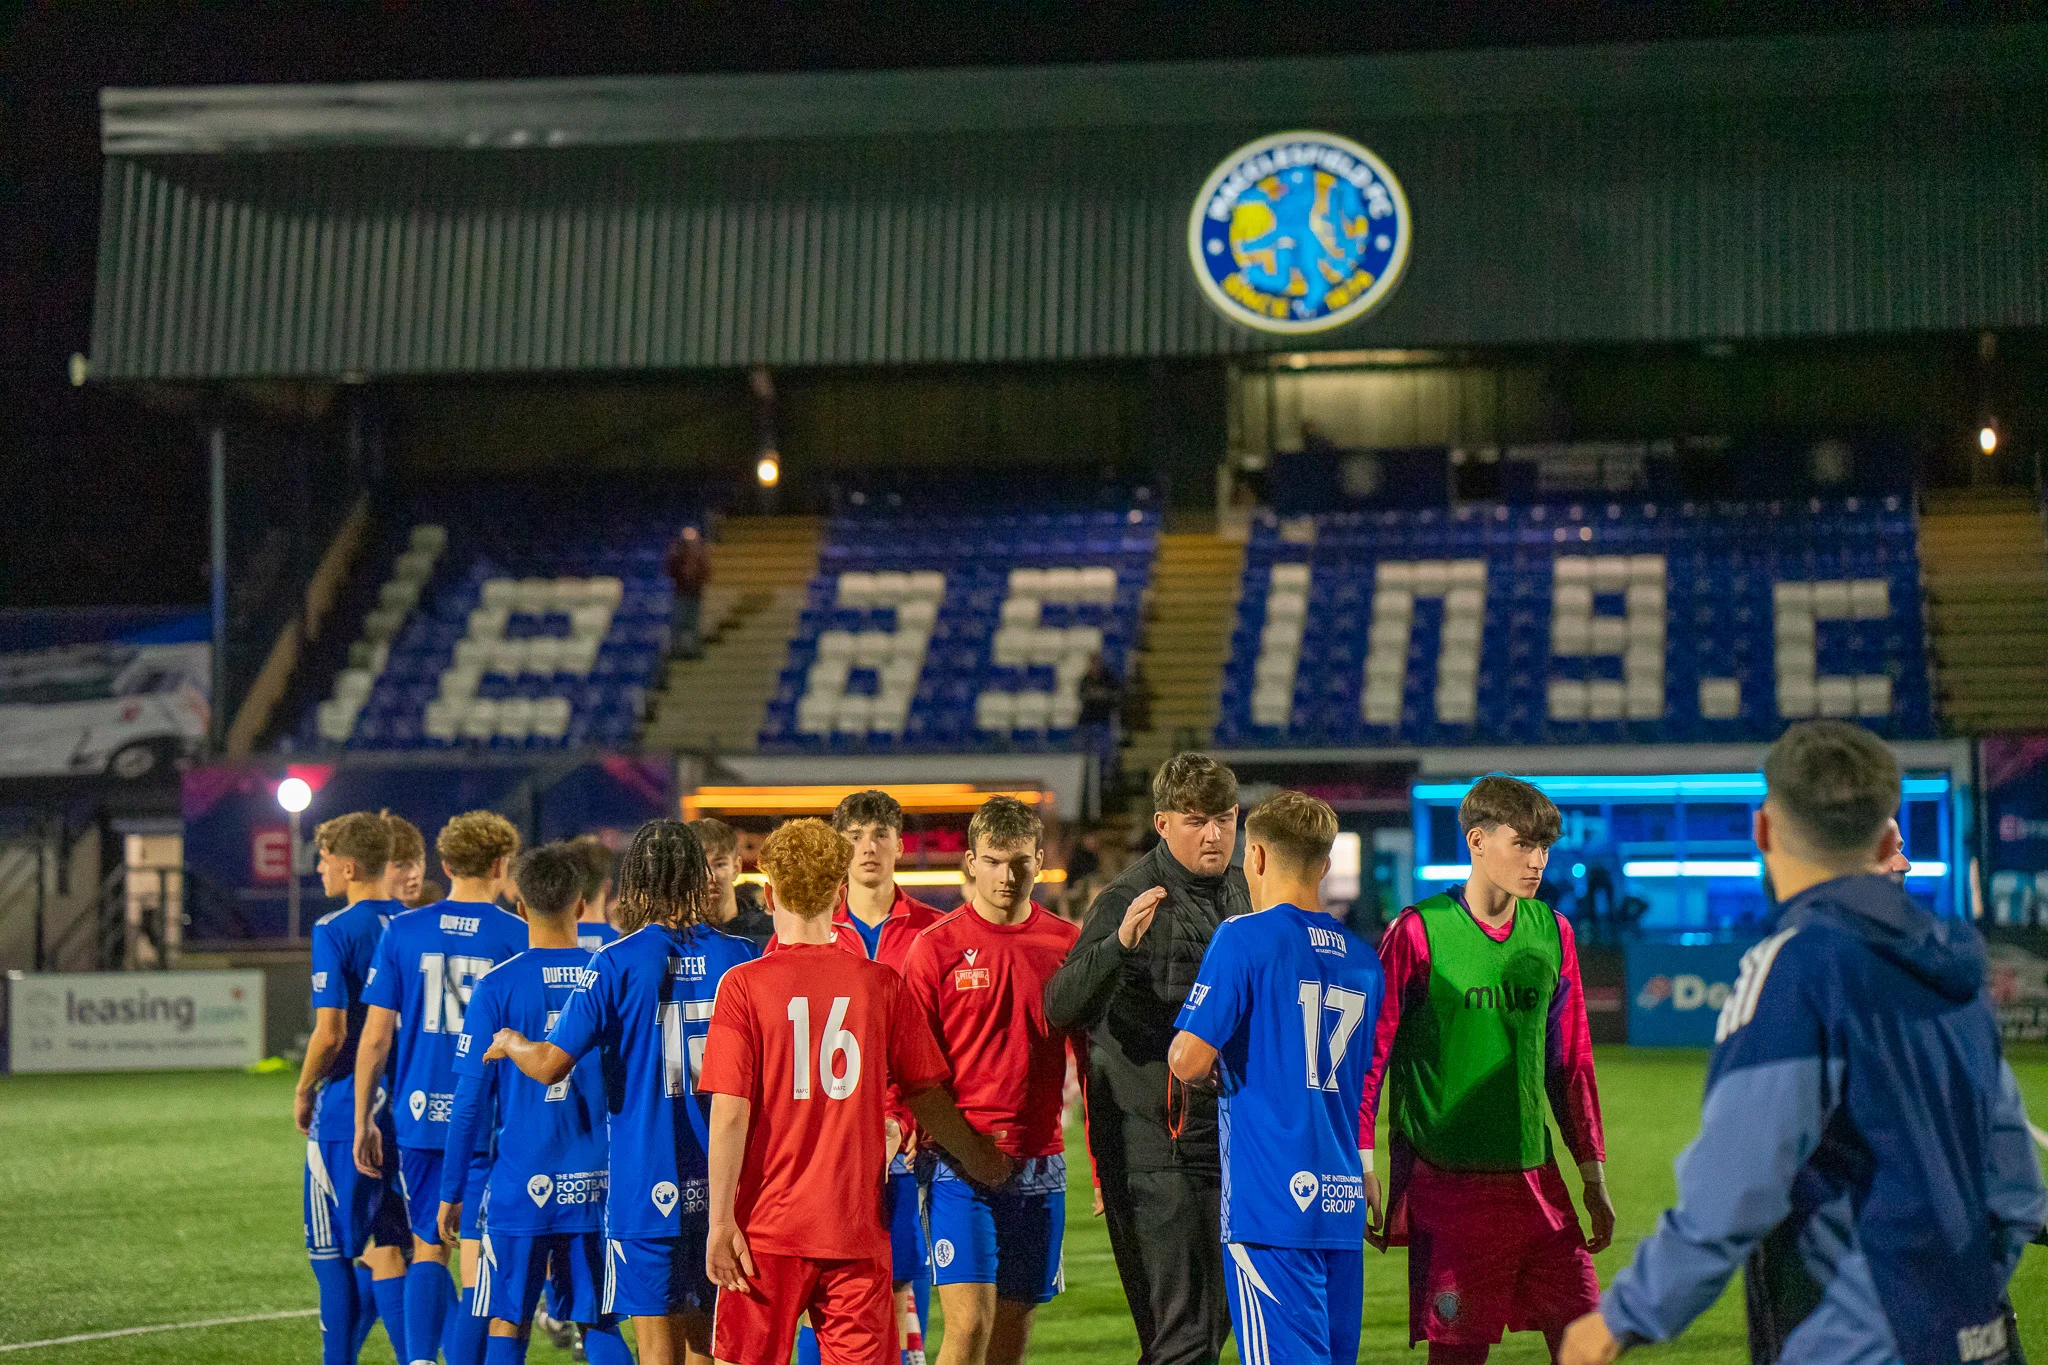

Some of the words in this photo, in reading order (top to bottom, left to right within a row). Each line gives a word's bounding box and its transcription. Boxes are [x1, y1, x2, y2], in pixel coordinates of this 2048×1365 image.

[1307, 926, 1347, 954] DUFFER
[542, 966, 583, 985] DUFFER
[666, 955, 707, 976] DUFFER
[1297, 980, 1367, 1093] 17
[787, 996, 861, 1100] 16
[556, 1191, 601, 1205] GROUP
[1321, 1184, 1364, 1199] FOOTBALL
[1321, 1199, 1356, 1213] GROUP
